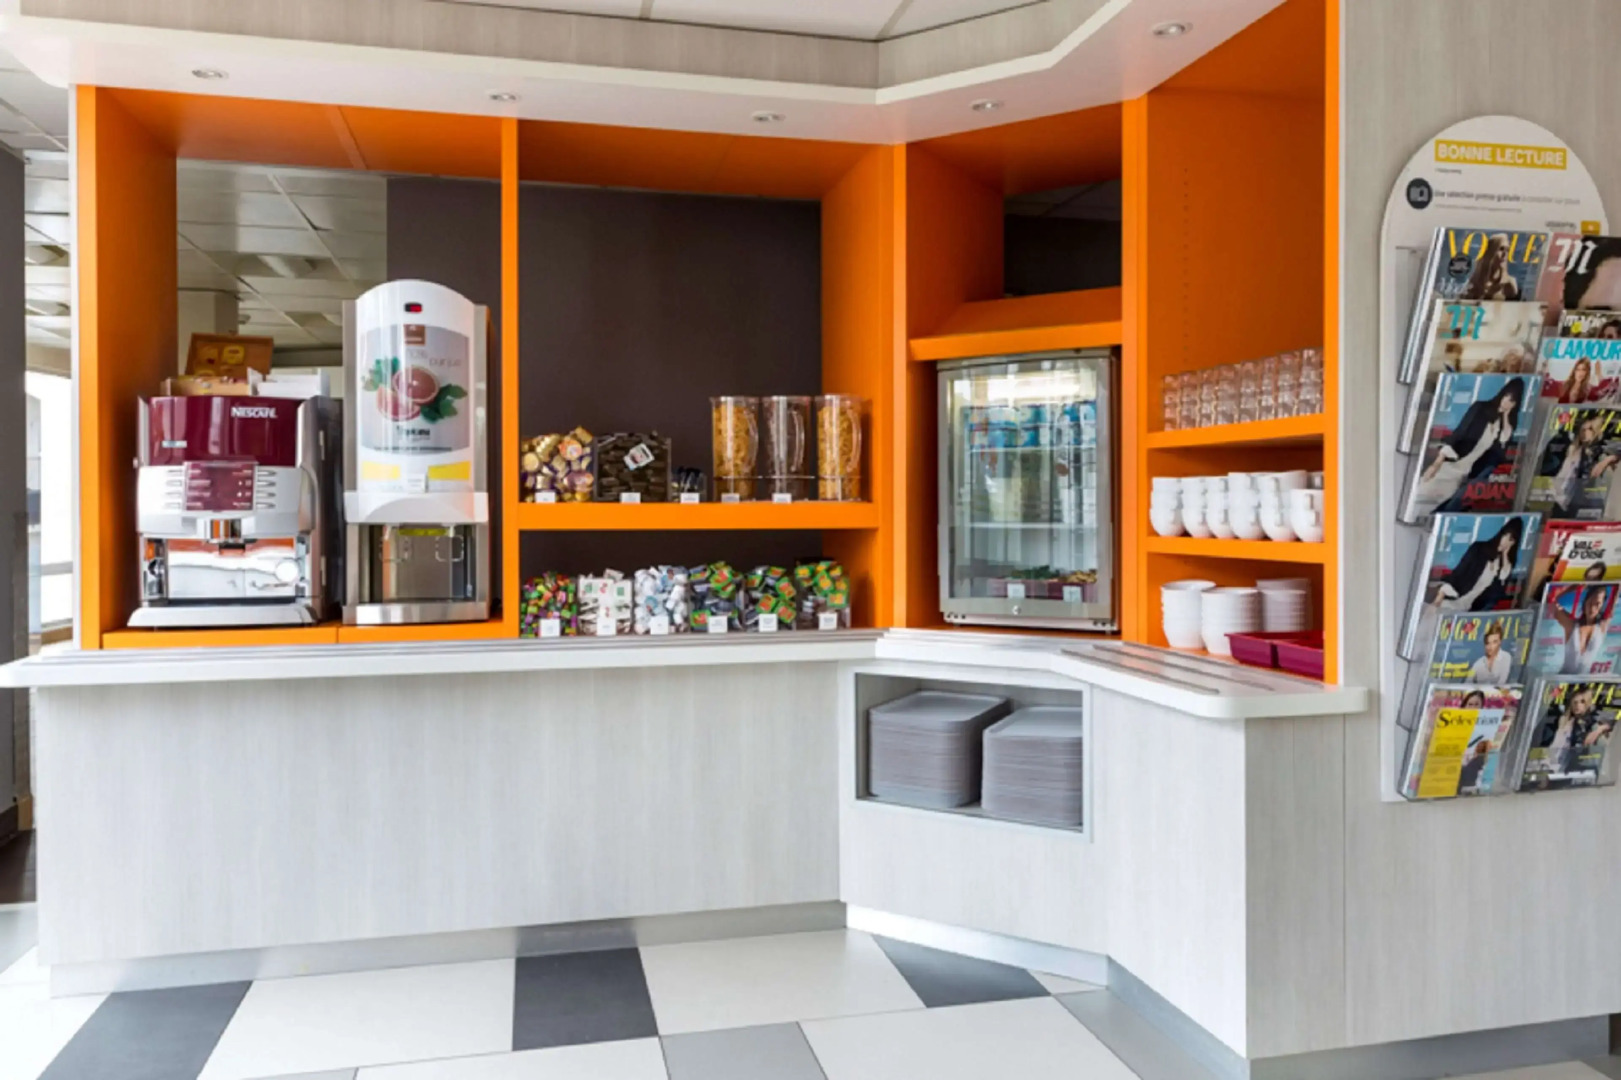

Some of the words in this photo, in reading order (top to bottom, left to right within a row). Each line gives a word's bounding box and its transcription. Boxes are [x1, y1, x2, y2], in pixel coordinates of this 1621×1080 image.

[1437, 143, 1493, 161] BONNE
[1495, 147, 1564, 166] LECTURE
[1448, 229, 1546, 264] VOUE
[1543, 338, 1621, 361] GLAMOUR
[1439, 375, 1542, 412] ELE
[1438, 516, 1542, 552] ELE
